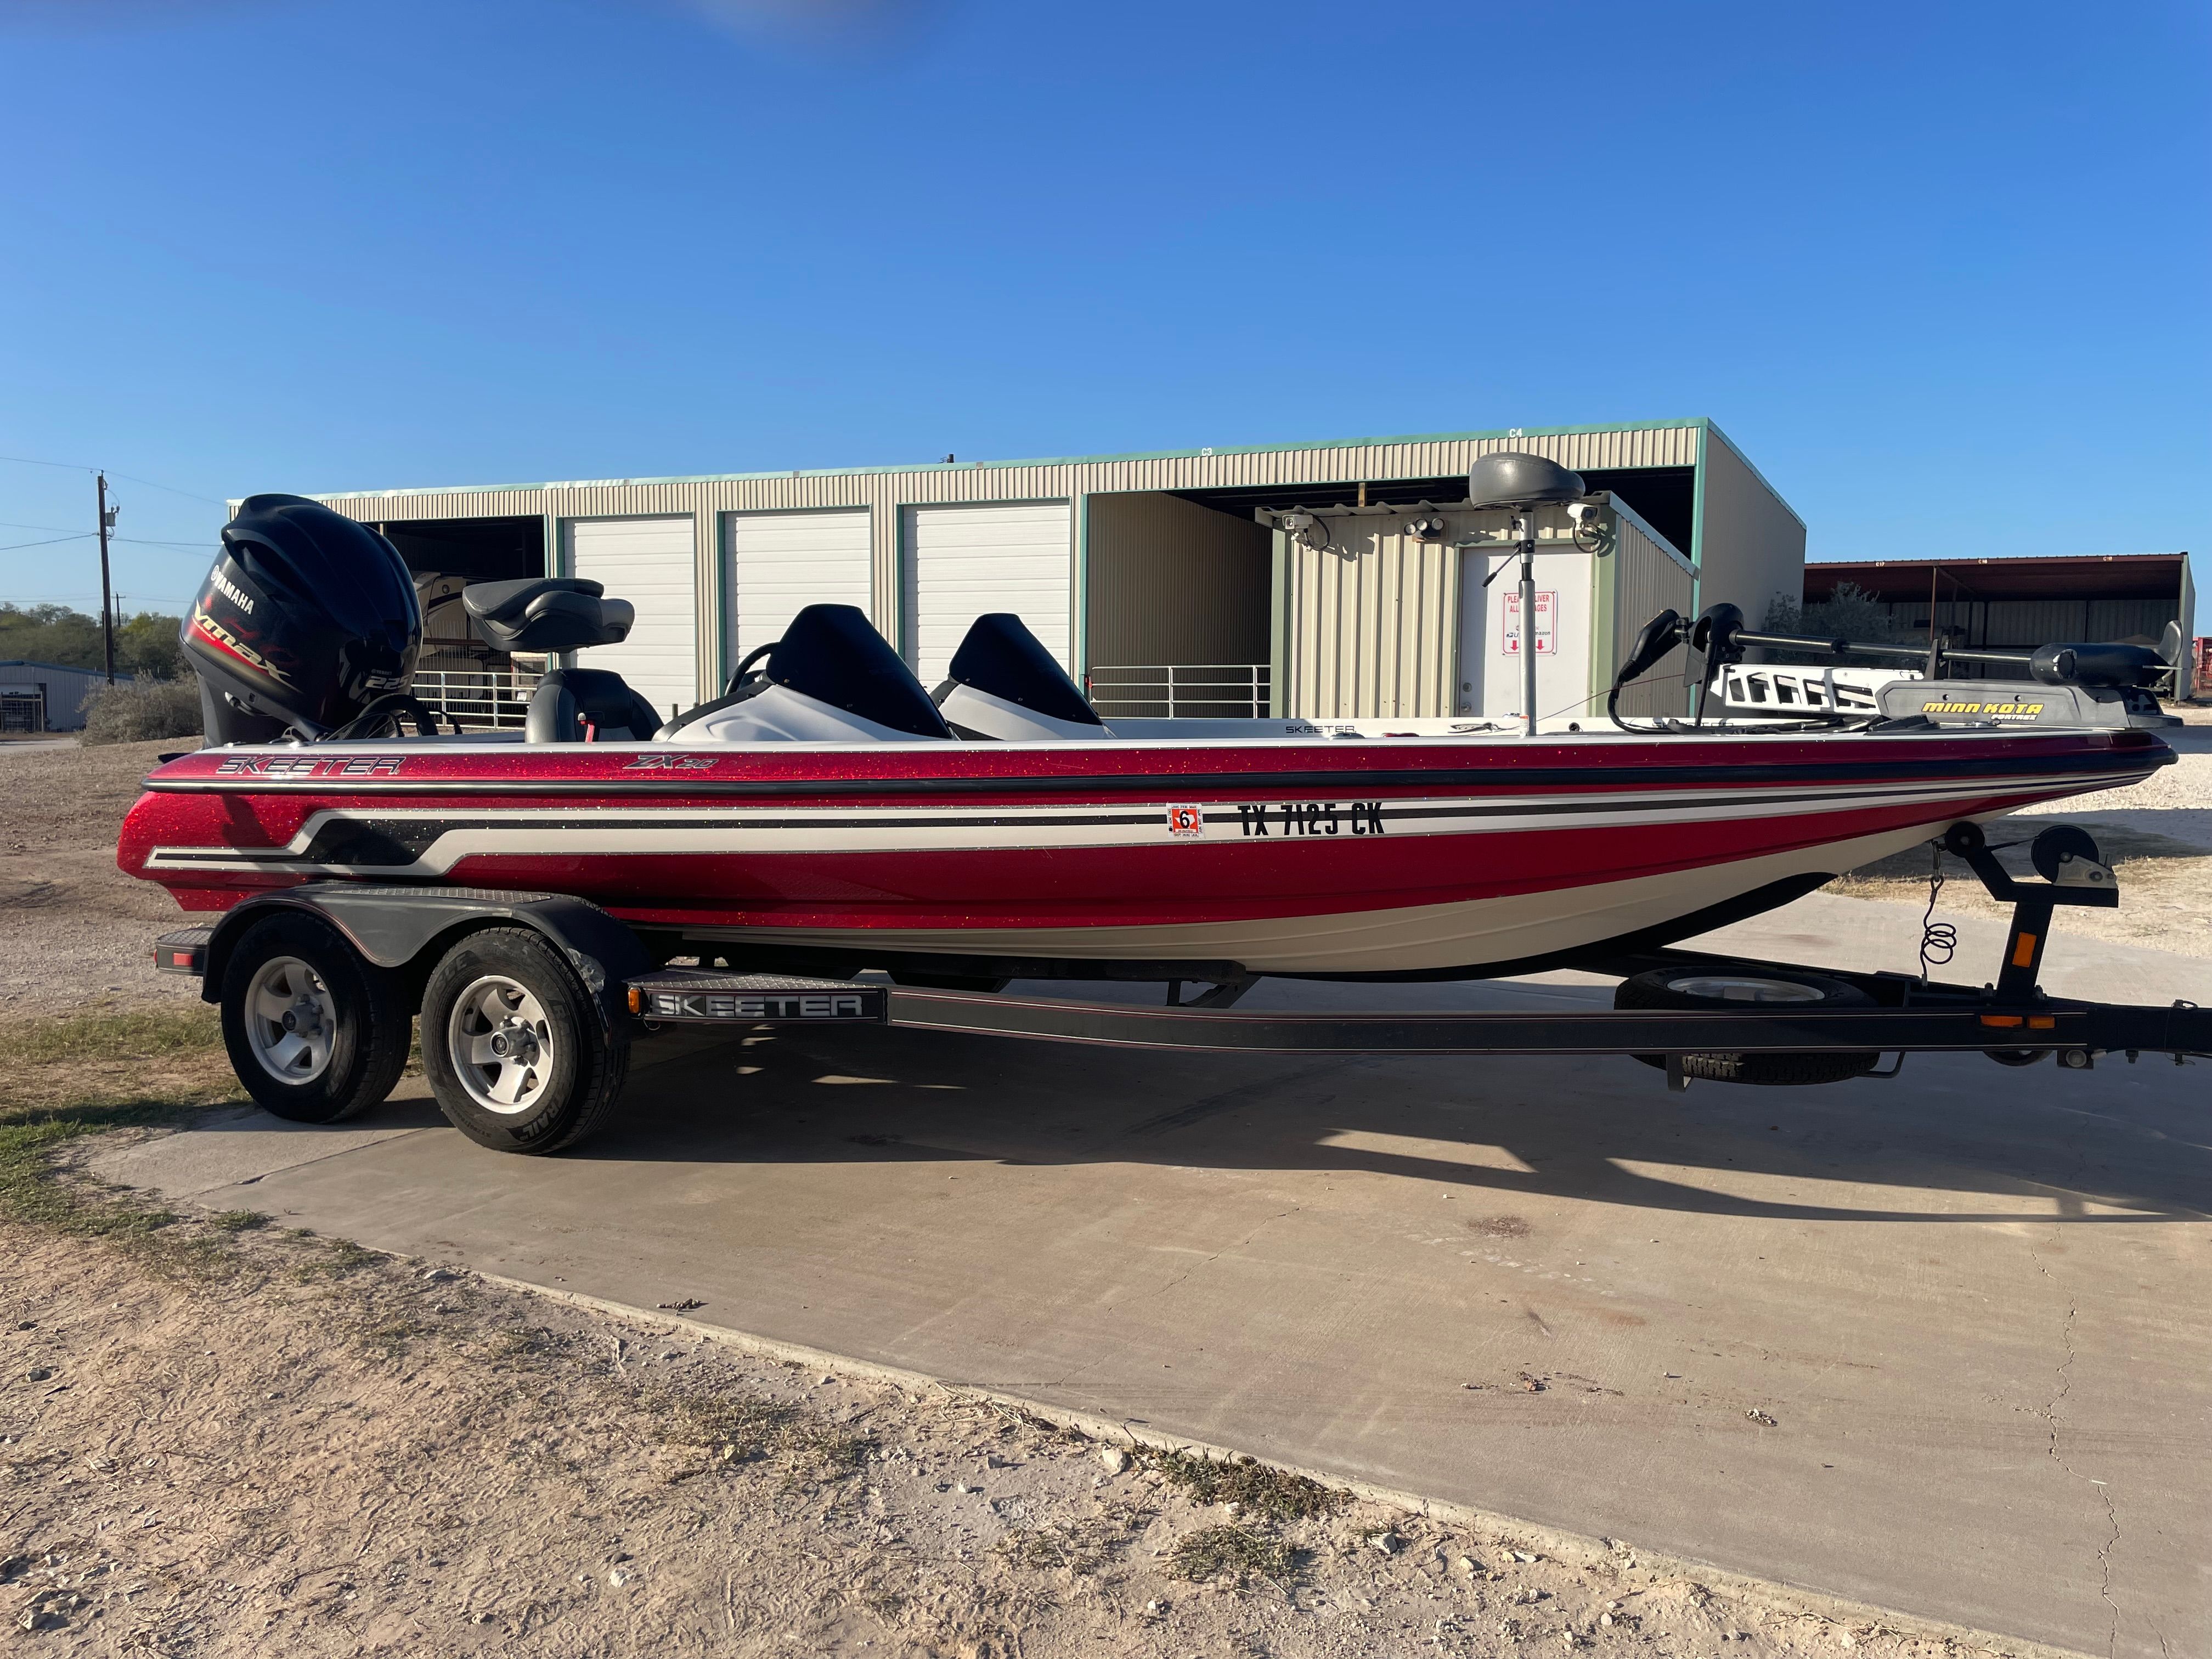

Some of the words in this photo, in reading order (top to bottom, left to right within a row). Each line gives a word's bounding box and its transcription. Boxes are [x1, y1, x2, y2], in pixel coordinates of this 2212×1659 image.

[1509, 428, 1522, 438] C4
[1201, 447, 1212, 456] C3
[214, 571, 255, 615] YAMAHA
[365, 674, 410, 690] 225
[1982, 703, 2045, 714] KOTA
[1285, 725, 1355, 733] SKEETER
[216, 755, 407, 775] SKEETER
[1180, 811, 1190, 829] 6
[1237, 805, 1268, 836] TX
[1280, 803, 1338, 836] 7125
[1351, 802, 1385, 835] CK
[651, 994, 863, 1018] SKEETER
